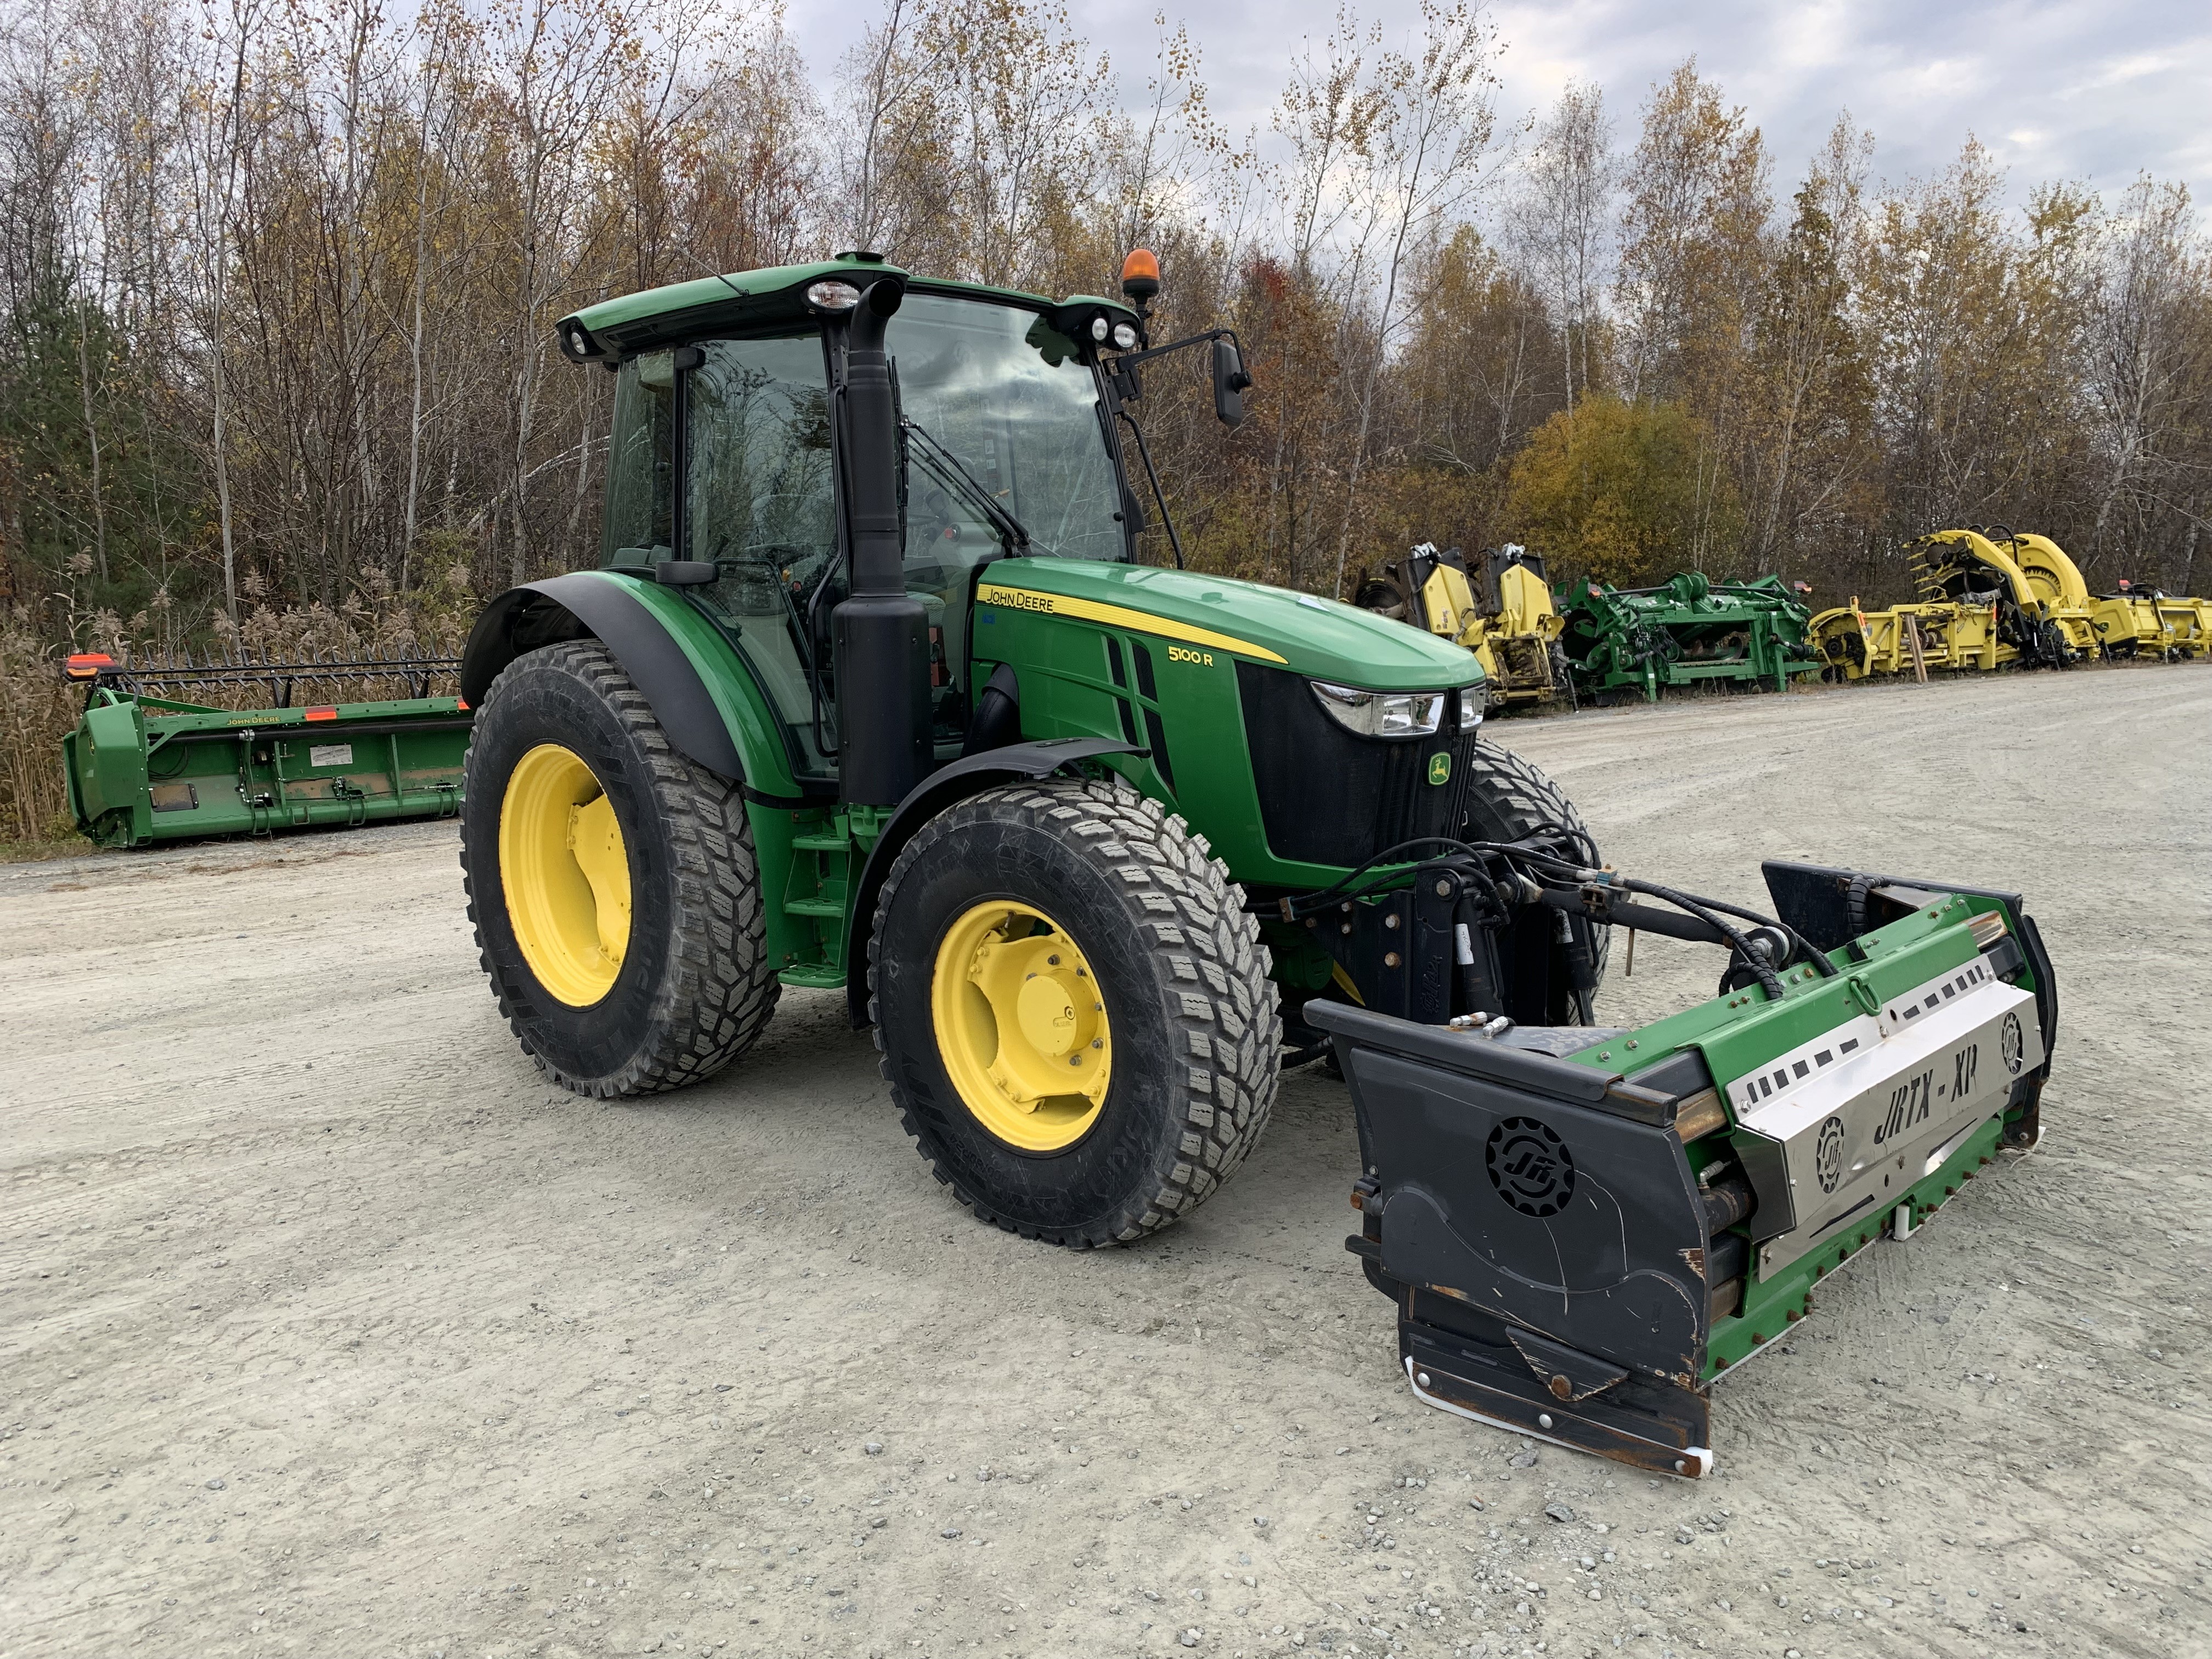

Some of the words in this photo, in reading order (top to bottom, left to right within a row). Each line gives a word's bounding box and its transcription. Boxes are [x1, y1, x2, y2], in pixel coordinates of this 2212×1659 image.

[987, 589, 1015, 605] JOHN
[1017, 592, 1054, 611] DEERE
[1874, 1069, 1933, 1144] JRTX
[1503, 1152, 1557, 1185] JR
